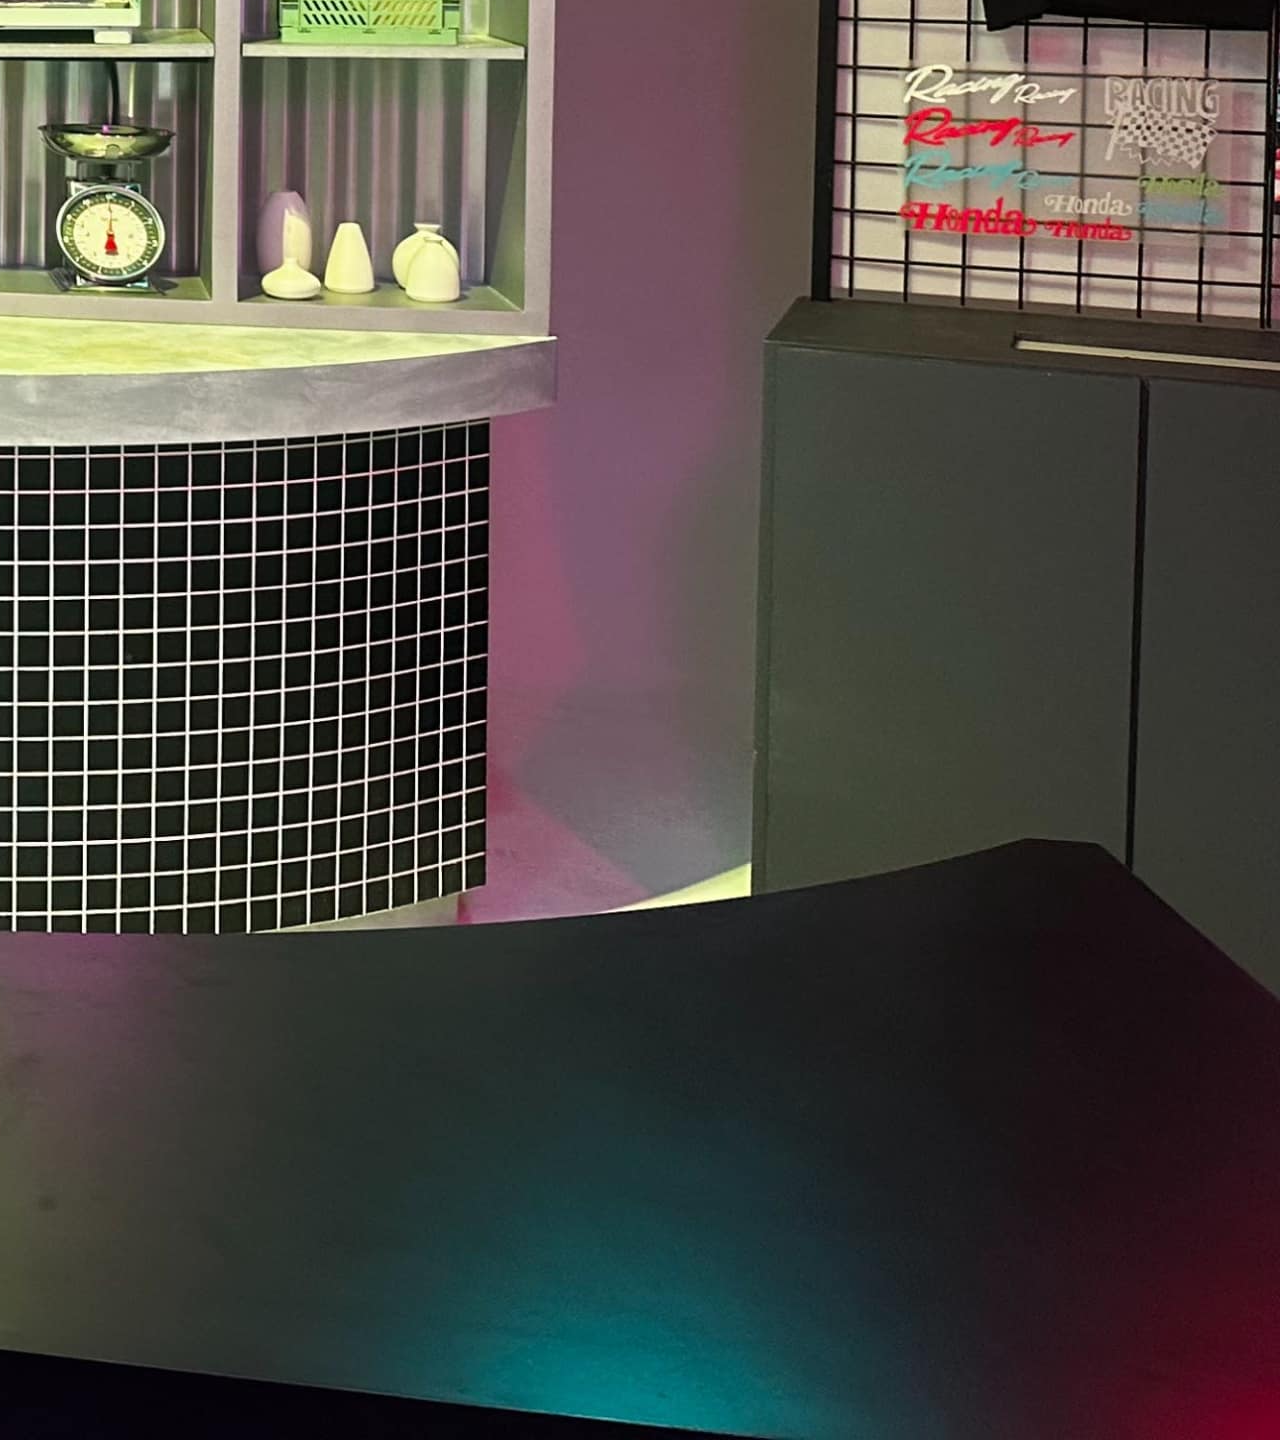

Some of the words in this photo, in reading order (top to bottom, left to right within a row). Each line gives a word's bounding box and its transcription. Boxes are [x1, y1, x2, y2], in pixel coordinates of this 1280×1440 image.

[904, 64, 1026, 104] Racing
[1104, 76, 1220, 119] RACING
[900, 196, 1038, 237] Honda
[1044, 192, 1133, 216] Honda
